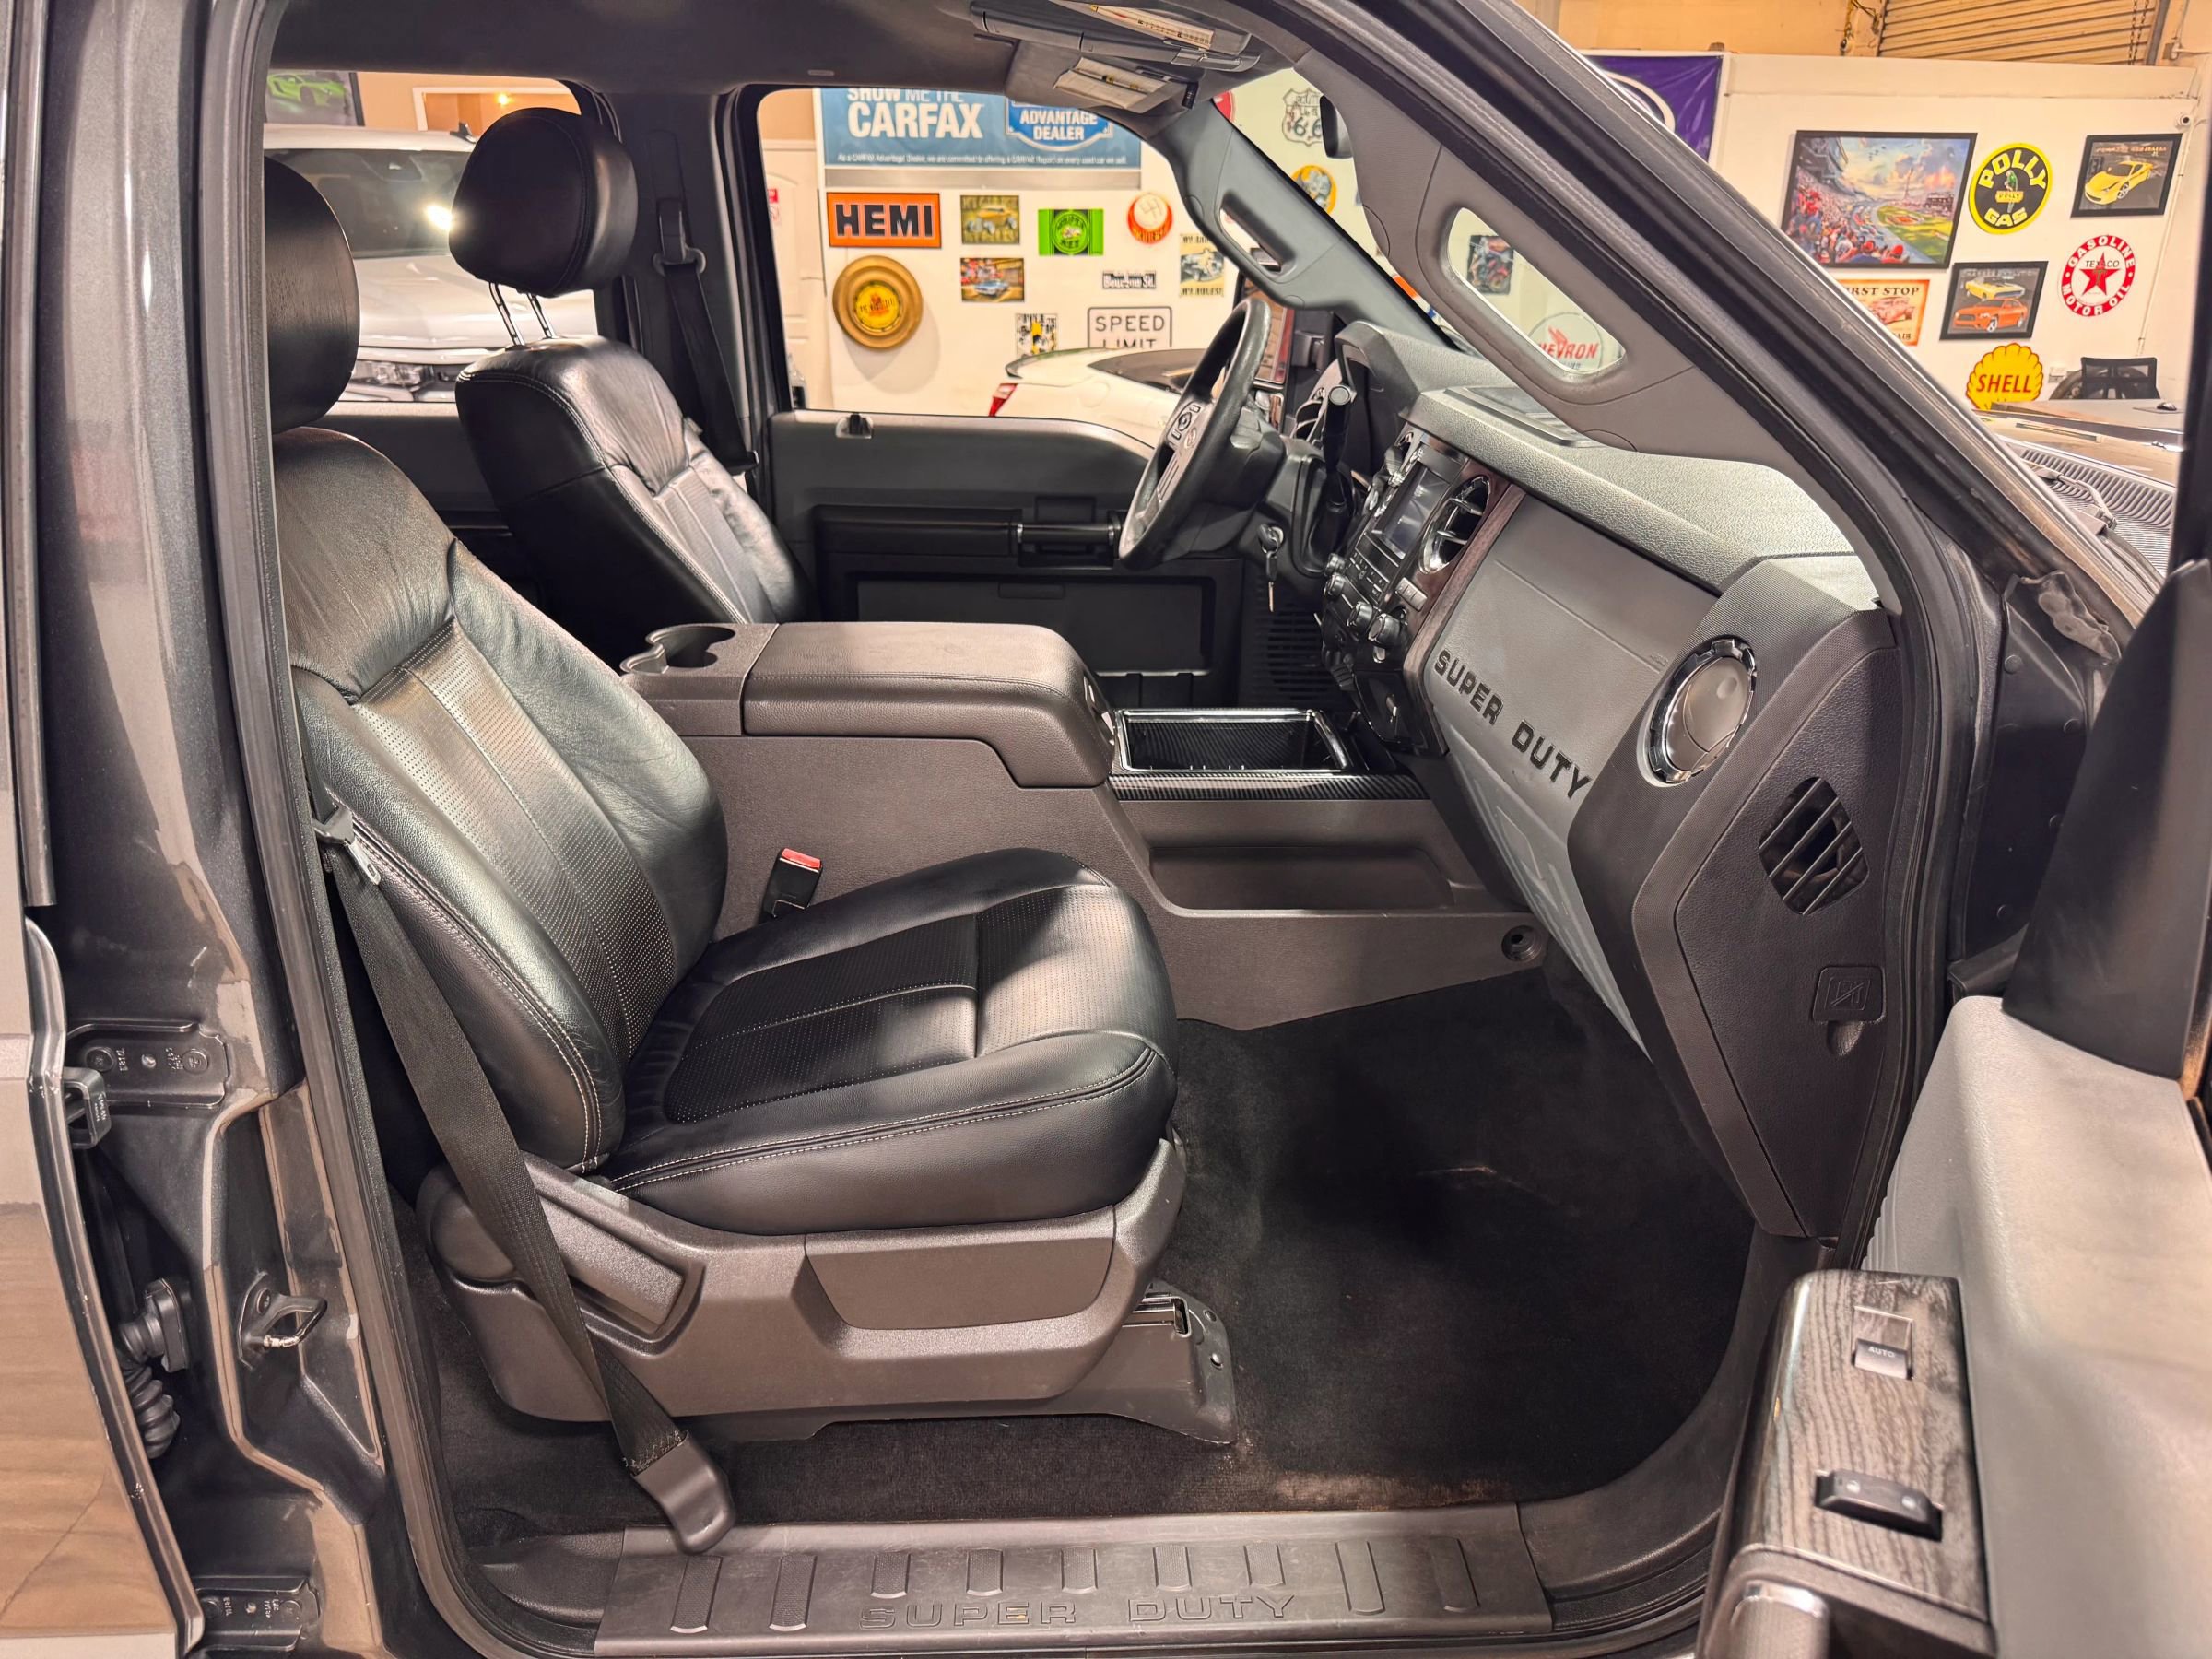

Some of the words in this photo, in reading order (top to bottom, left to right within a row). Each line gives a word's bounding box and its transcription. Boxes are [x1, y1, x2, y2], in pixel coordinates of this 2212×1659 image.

[847, 88, 900, 101] SHOW
[905, 89, 930, 102] ME
[847, 101, 983, 138] CARFAX
[1019, 110, 1098, 125] ADVANTAGE
[1033, 125, 1085, 140] DEALER
[1978, 150, 2046, 189] POLLY
[836, 205, 933, 237] HEMI
[1984, 207, 2028, 227] GAS
[2067, 236, 2135, 268] GASOLINE
[1844, 287, 1878, 296] IRST
[1883, 287, 1919, 296] STOP
[2062, 283, 2103, 316] MOTOR
[2109, 285, 2130, 307] OIL
[1095, 315, 1165, 332] SPEED
[1976, 374, 2031, 393] SHELL
[1433, 648, 1504, 725] SUPER
[1512, 719, 1593, 799] DUTY
[1868, 1347, 1896, 1358] AUTO
[858, 1601, 1077, 1629] SUPER
[1128, 1594, 1295, 1622] DUTY
